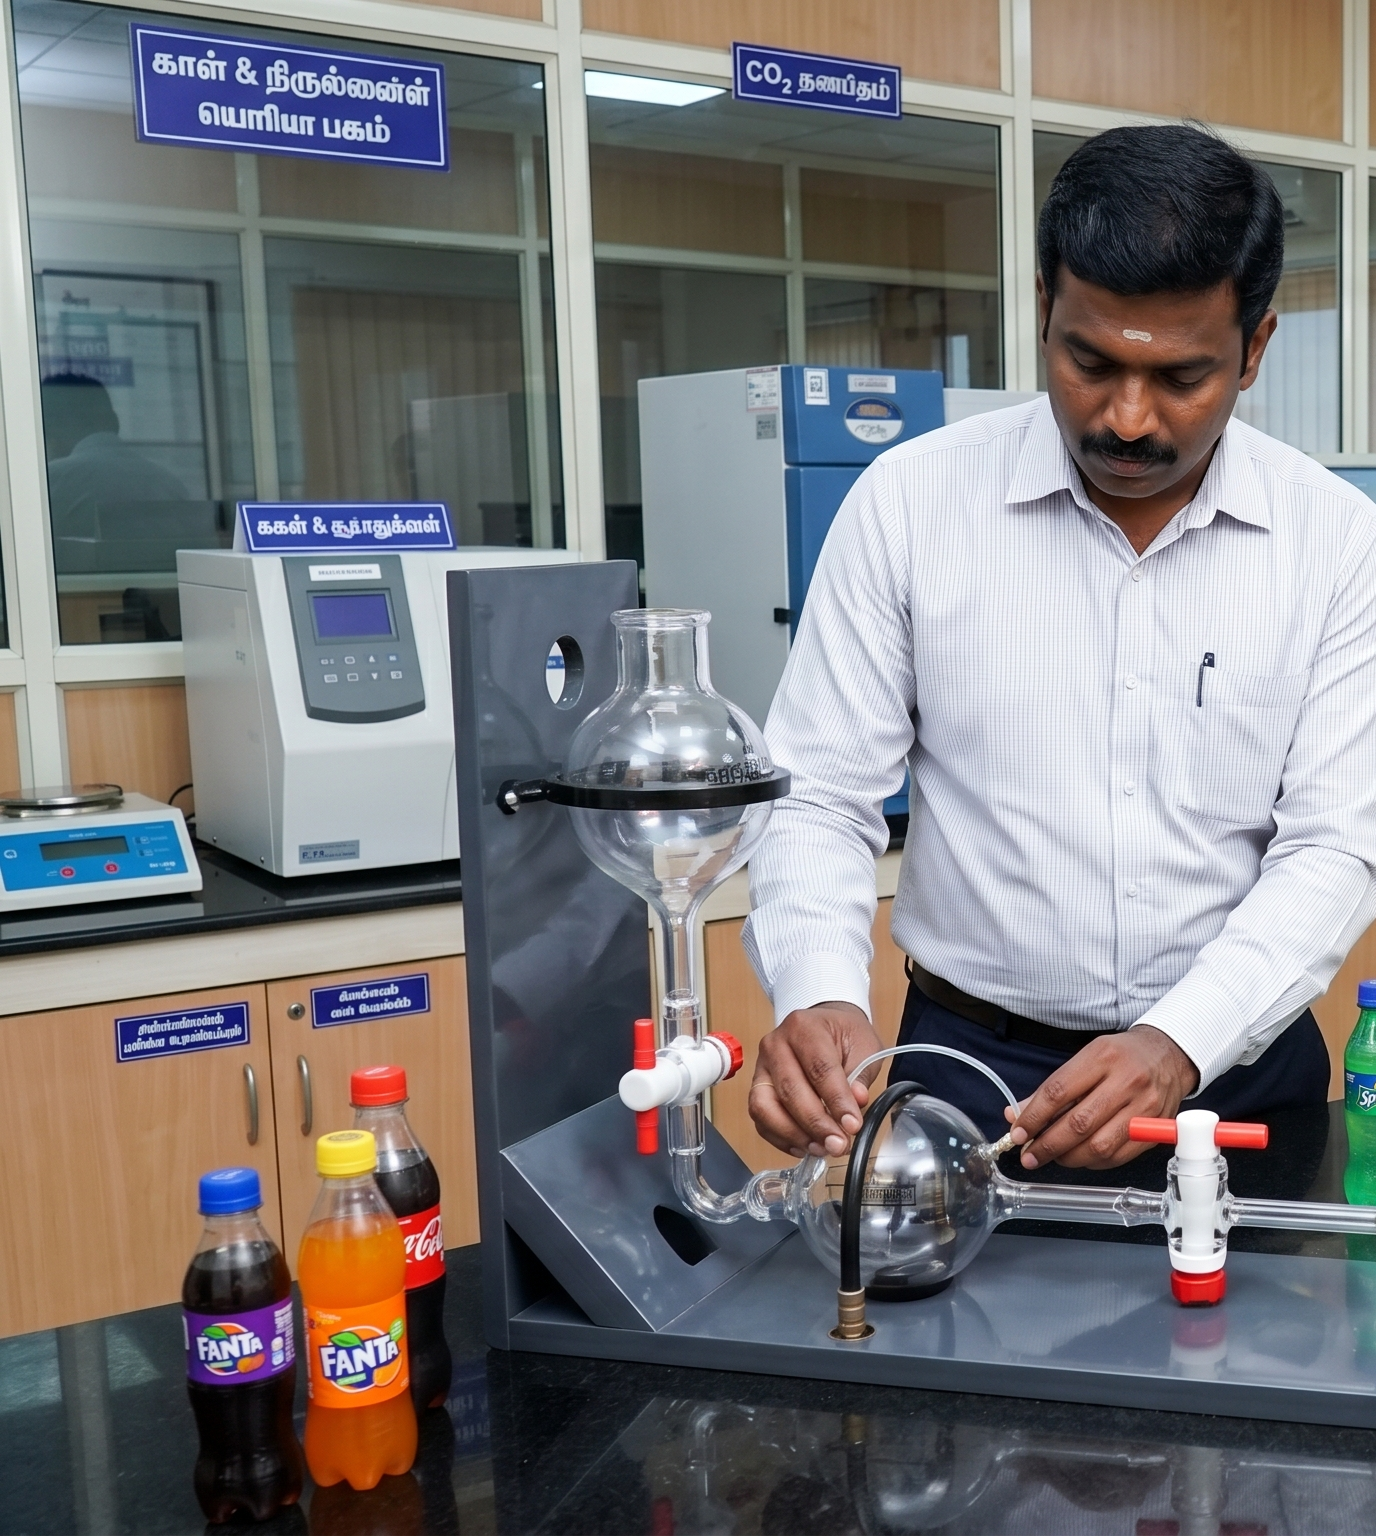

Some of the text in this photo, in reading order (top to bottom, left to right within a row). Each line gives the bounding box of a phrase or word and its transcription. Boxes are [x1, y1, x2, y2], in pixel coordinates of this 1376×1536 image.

[234, 56, 260, 86] &
[322, 114, 391, 144] பகம்
[312, 516, 329, 535] &
[320, 1334, 399, 1377] FANTA
